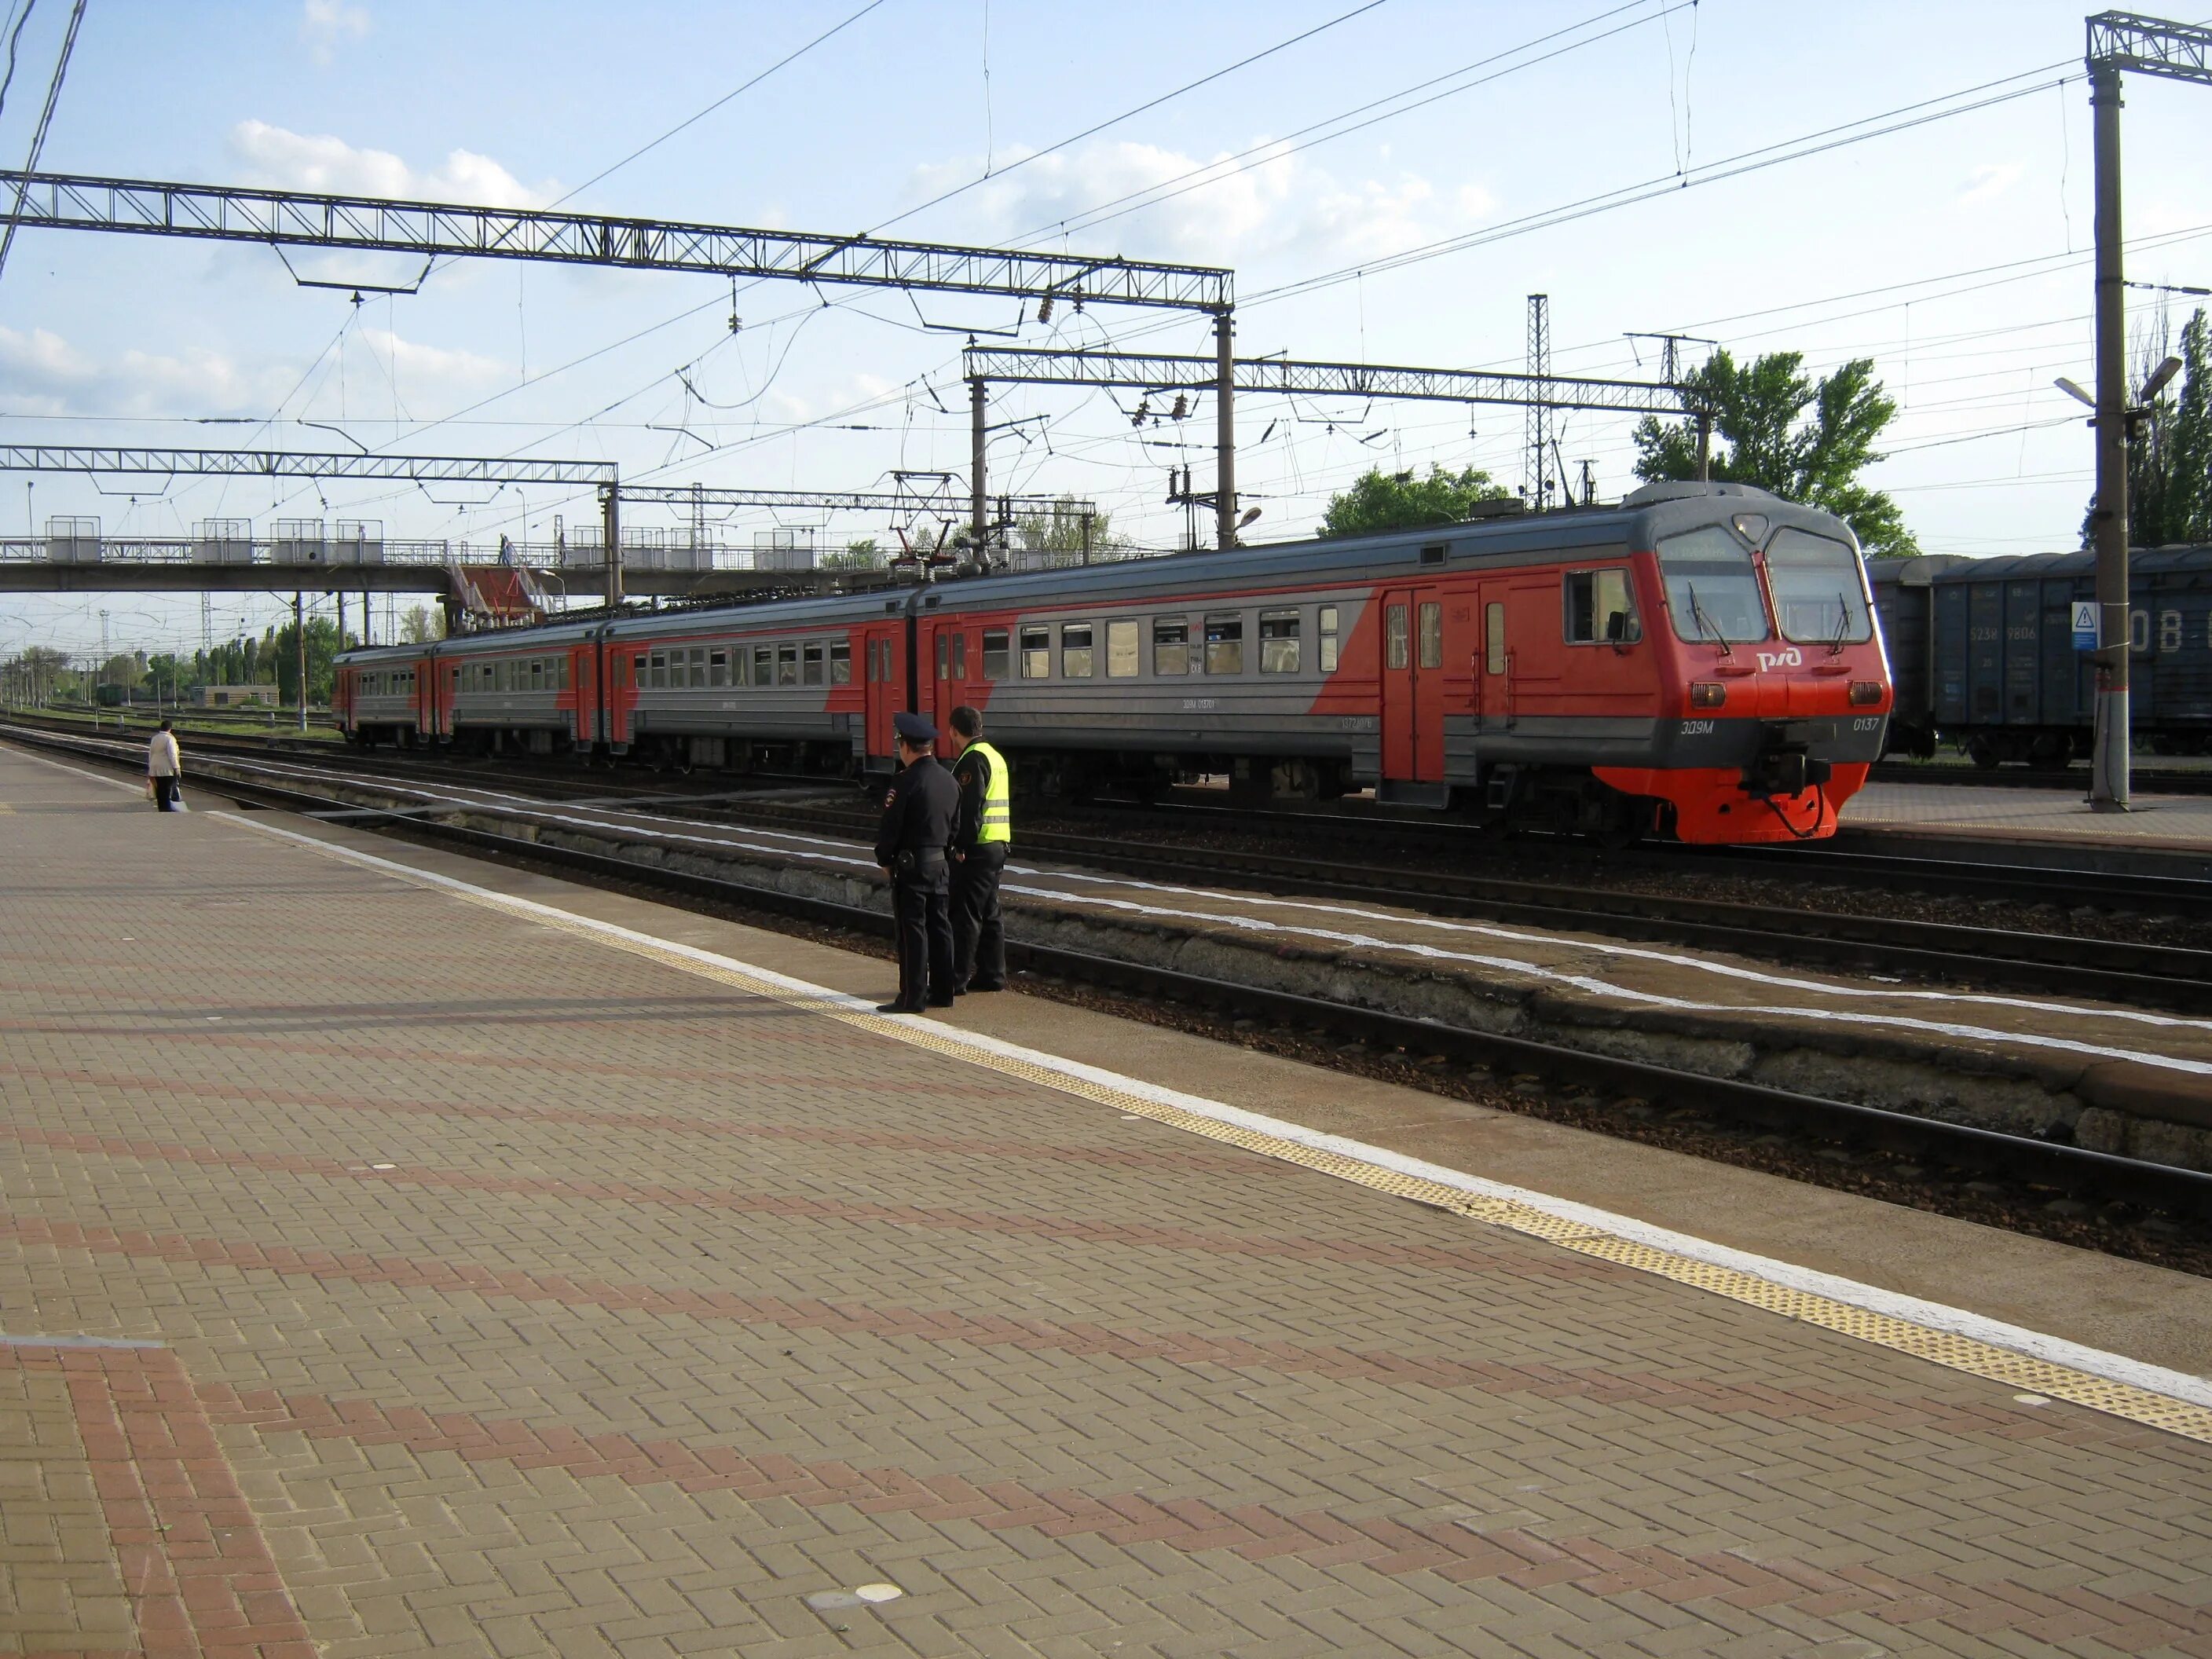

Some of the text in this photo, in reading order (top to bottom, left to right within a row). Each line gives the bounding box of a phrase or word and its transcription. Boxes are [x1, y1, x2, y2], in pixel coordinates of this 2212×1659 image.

[1970, 626, 2036, 641] 5238 9806
[1681, 720, 1714, 734] ЭД9М
[1854, 718, 1879, 731] 0137
